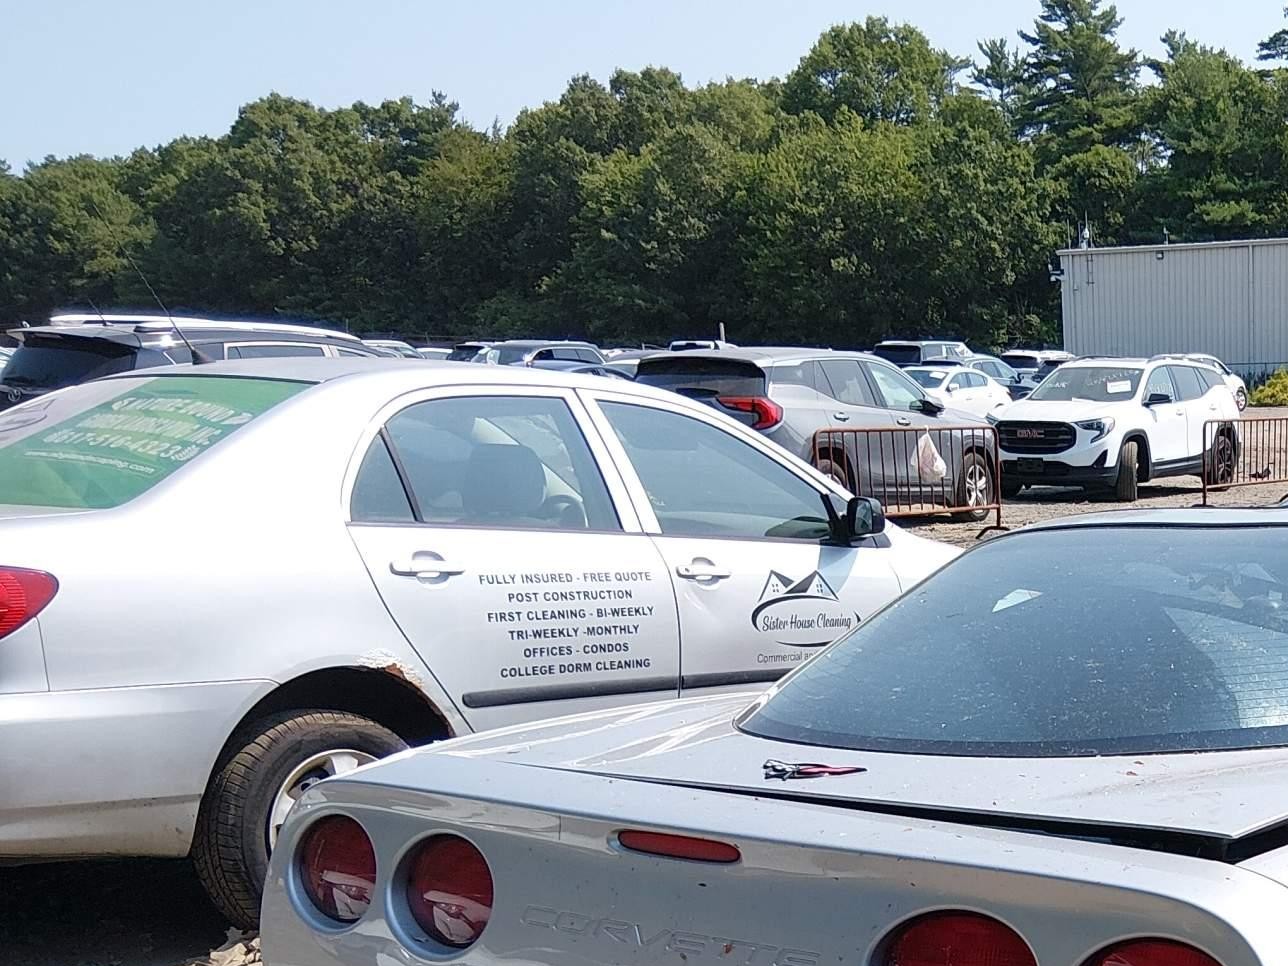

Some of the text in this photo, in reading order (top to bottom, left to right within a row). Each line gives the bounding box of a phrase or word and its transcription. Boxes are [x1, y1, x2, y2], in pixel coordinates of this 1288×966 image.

[479, 574, 517, 585] FULLY
[521, 573, 573, 584] INSURED
[583, 572, 611, 583] FREE
[615, 571, 652, 582] QUOTE
[508, 590, 633, 603] POST CONSTRUCTION
[488, 611, 523, 622] FIRST
[527, 609, 586, 621] CLEANING
[596, 606, 654, 618] BI-WEEKLY
[762, 613, 851, 631] Sister House Cleaning
[508, 624, 640, 641] TRI-WEEKLY -MONTHLY
[523, 646, 573, 658] OFFICES
[583, 642, 629, 654] CONDOS
[757, 651, 816, 663] Commercial an
[500, 658, 650, 678] COLLEGE DORM CLEANING
